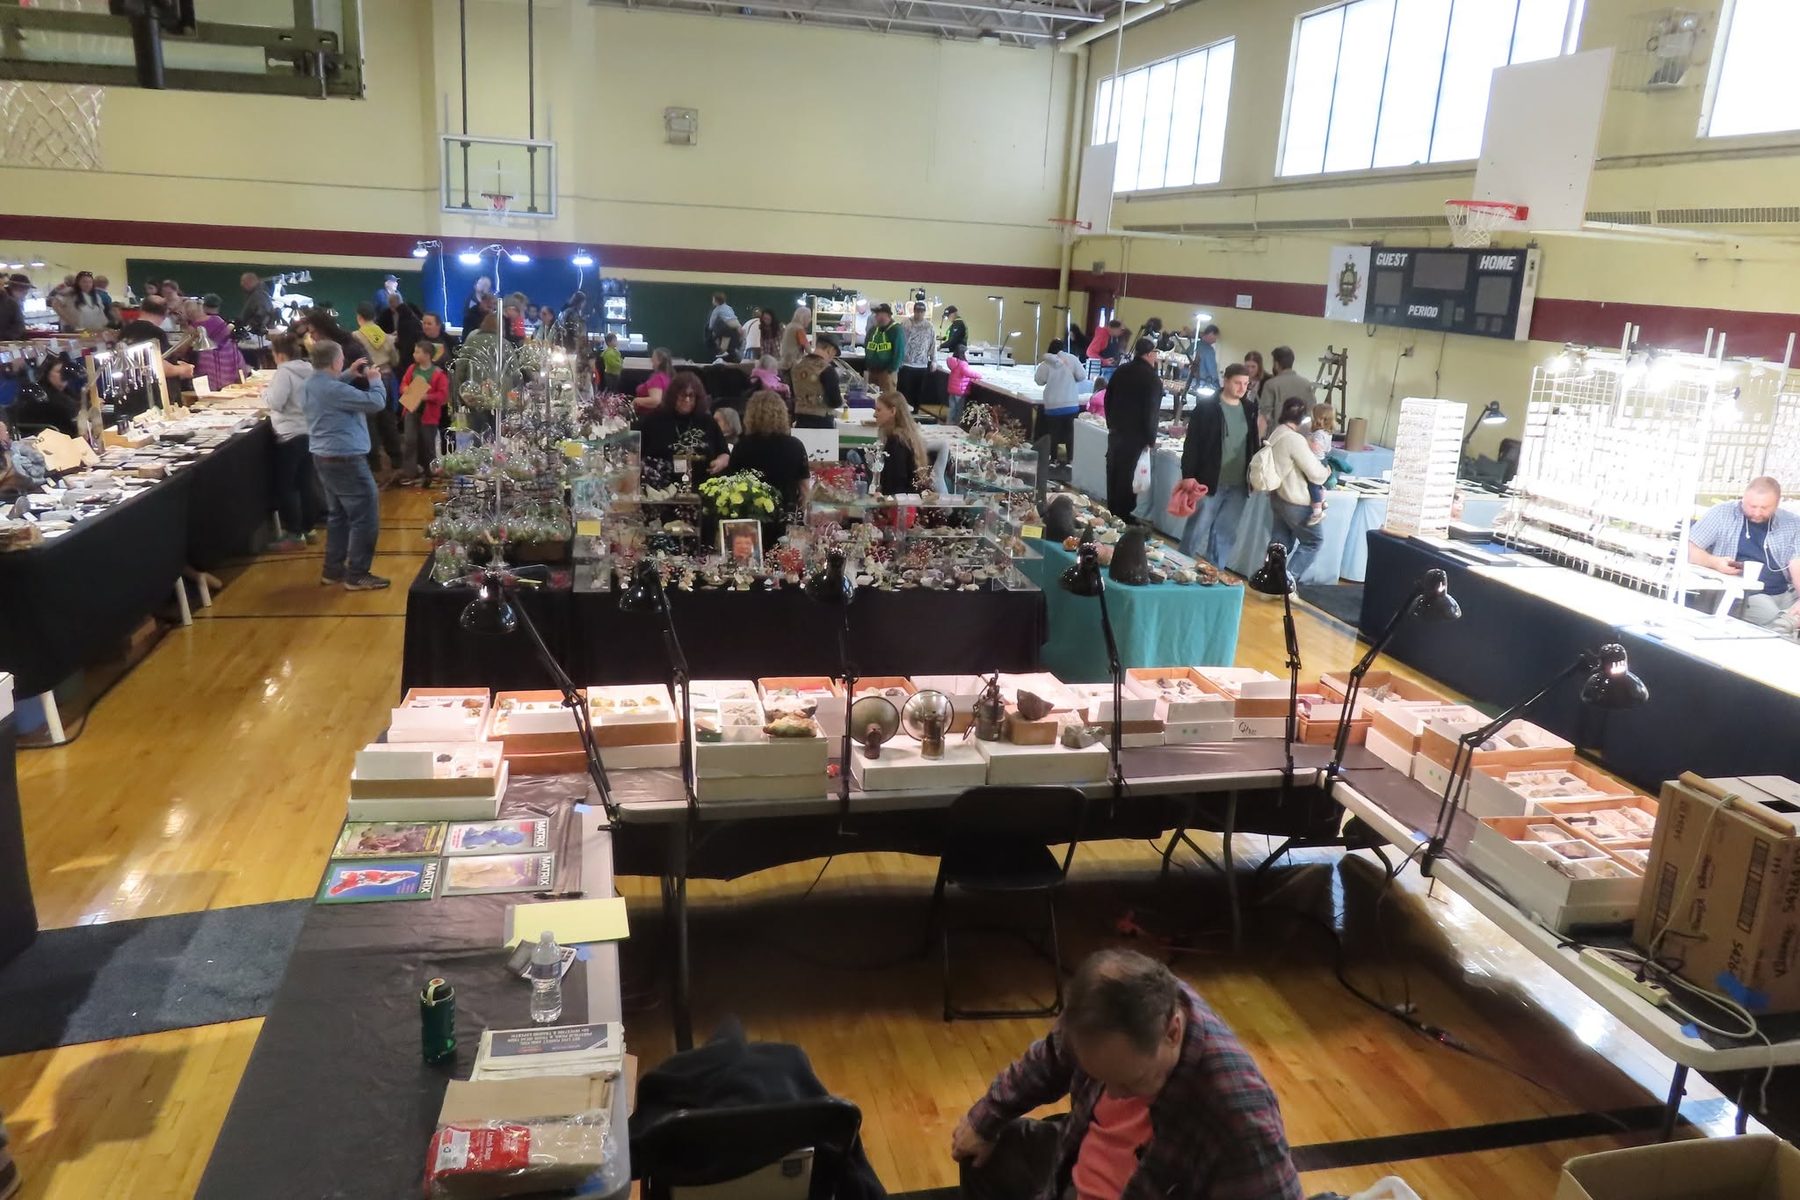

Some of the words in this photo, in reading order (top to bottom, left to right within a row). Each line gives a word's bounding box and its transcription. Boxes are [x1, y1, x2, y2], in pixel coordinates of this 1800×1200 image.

[1376, 253, 1408, 266] GUEST
[1479, 255, 1516, 271] HOME
[1407, 305, 1438, 317] PERIOD
[536, 820, 546, 847] MATRIX
[420, 863, 437, 893] MATRIX
[540, 856, 550, 885] MATRIX
[1728, 941, 1743, 974] 5426
